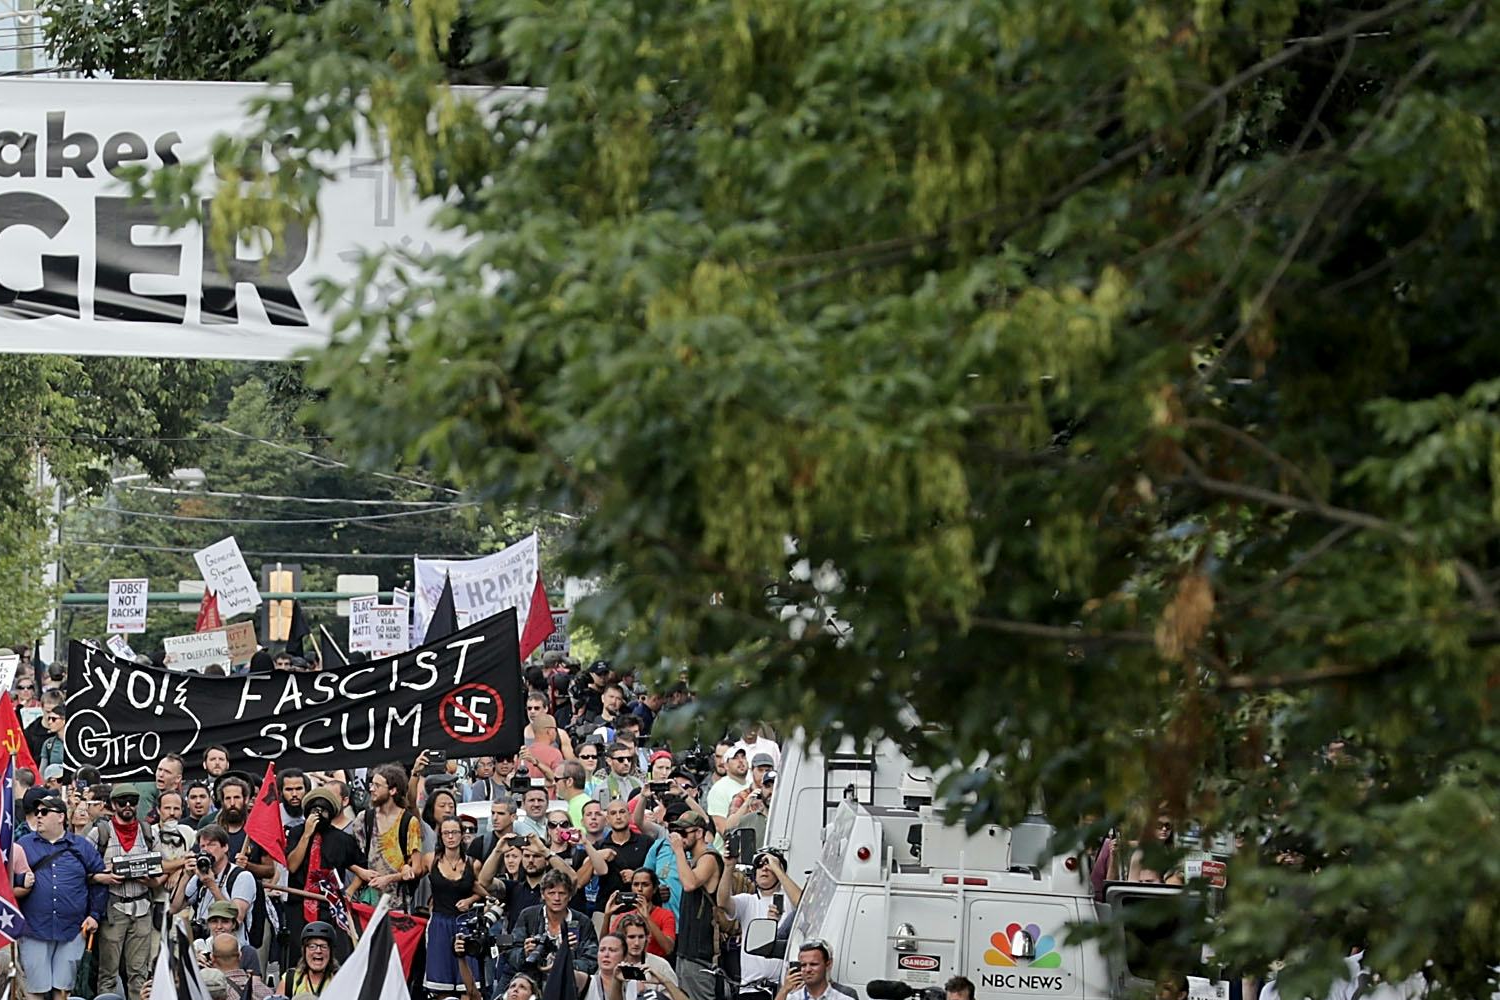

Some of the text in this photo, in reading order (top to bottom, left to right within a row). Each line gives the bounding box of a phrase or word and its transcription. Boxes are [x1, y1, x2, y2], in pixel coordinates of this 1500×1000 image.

[210, 563, 243, 581] Sherman
[115, 583, 143, 595] JOBS!
[118, 596, 137, 606] NOT
[227, 598, 252, 609] Wrong
[352, 601, 374, 613] BLACK
[111, 608, 144, 618] RACISM!
[354, 614, 369, 625] LIVE
[352, 626, 371, 637] MATT
[165, 633, 214, 646] TOLERANCE
[180, 647, 229, 661] TOLERATING
[235, 635, 486, 721] FASCIST
[94, 666, 171, 716] YO!
[242, 703, 423, 760] SCUM
[71, 718, 161, 768] GTFO
[903, 958, 936, 967] DANGER
[982, 974, 1063, 991] NBC NEWS
